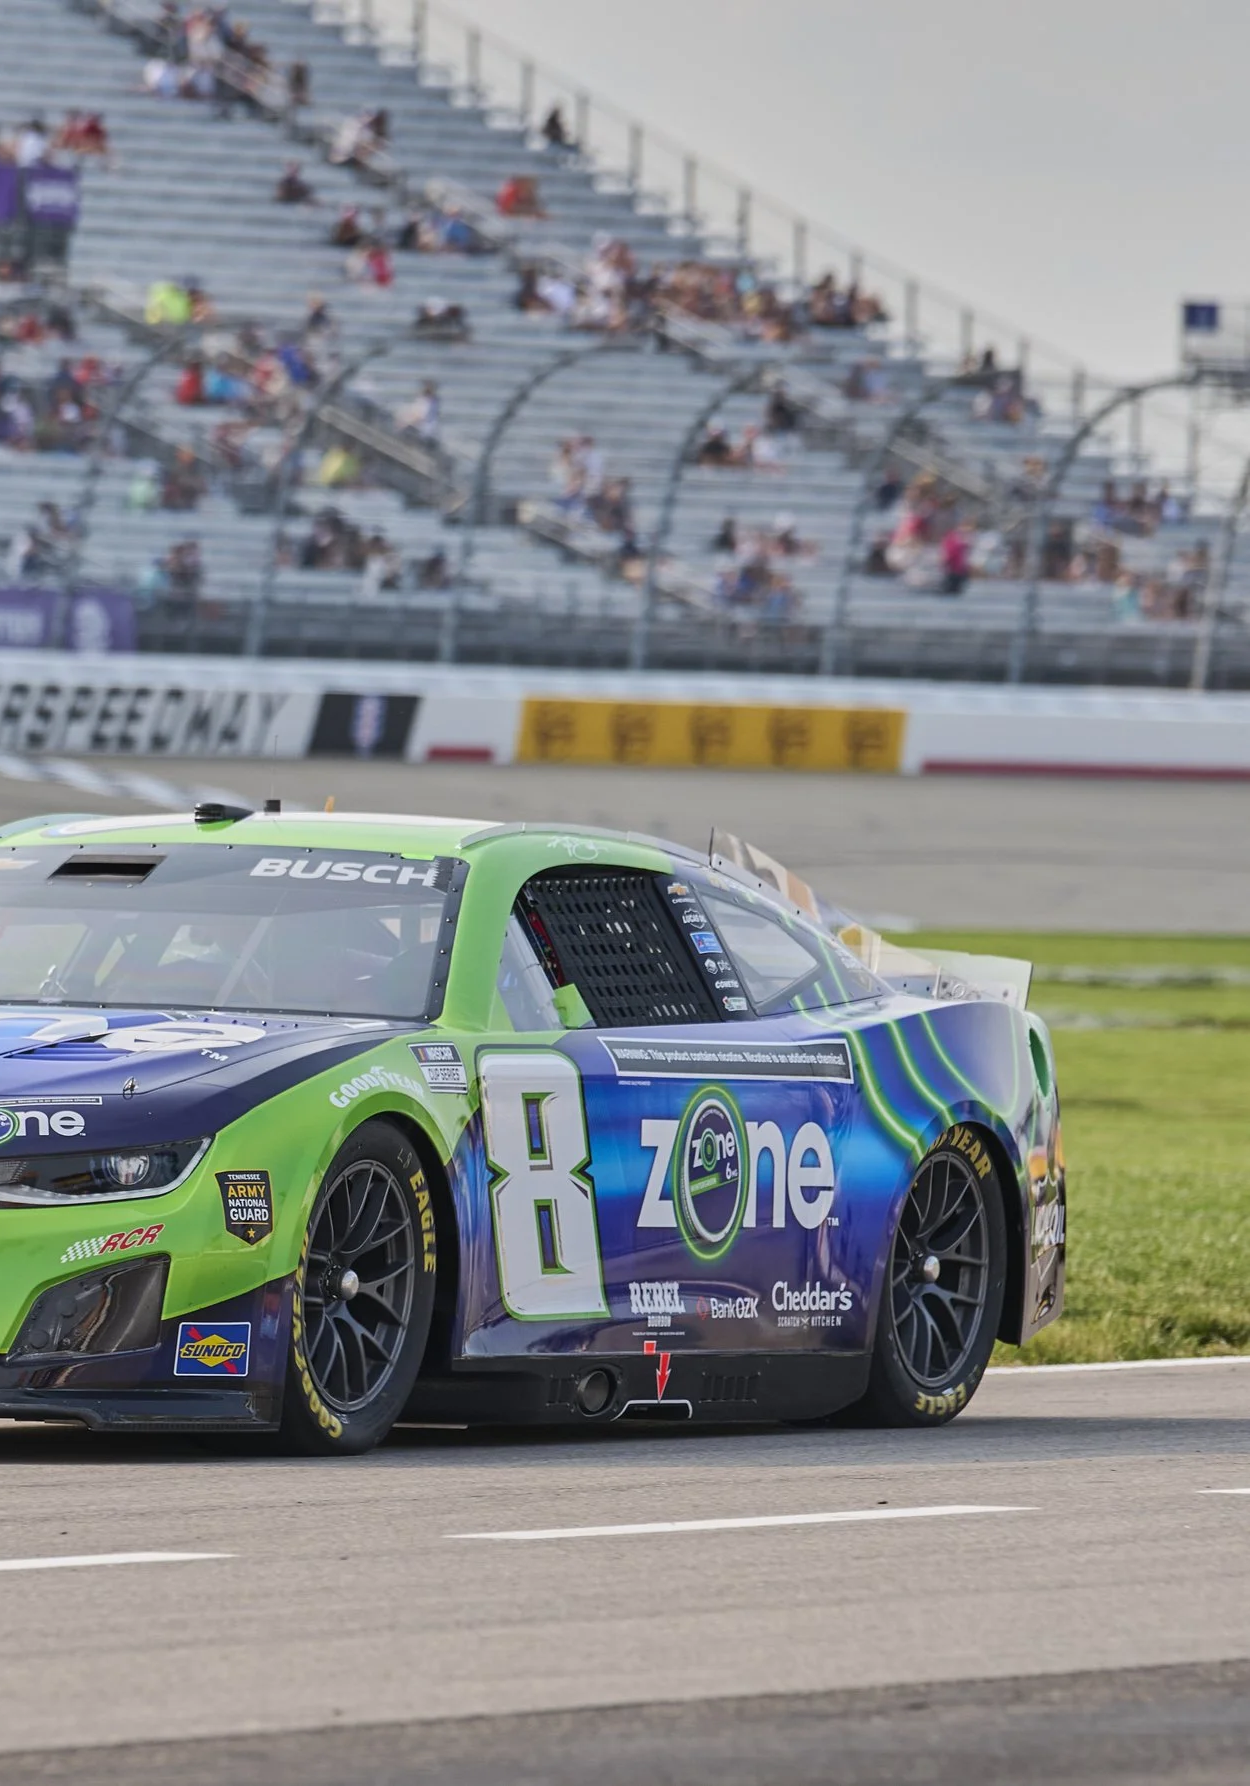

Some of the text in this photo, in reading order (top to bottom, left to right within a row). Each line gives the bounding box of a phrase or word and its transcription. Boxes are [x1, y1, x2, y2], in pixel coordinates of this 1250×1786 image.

[249, 857, 440, 888] BUSCH
[329, 1066, 425, 1108] GOODYEAR
[692, 1129, 735, 1170] zone
[227, 1173, 261, 1181] TENNESSEE
[475, 1045, 611, 1321] 8
[637, 1100, 835, 1241] zone
[228, 1184, 266, 1198] ARMY
[228, 1198, 268, 1208] NATIONAL
[230, 1208, 269, 1222] GUARD
[410, 1168, 436, 1274] EAGLE
[99, 1223, 165, 1256] RCR
[629, 1281, 686, 1314] REBEL
[771, 1281, 852, 1311] Cheddar's
[777, 1316, 842, 1327] SCRATCH KITCHEN
[181, 1343, 245, 1358] SUNOCO
